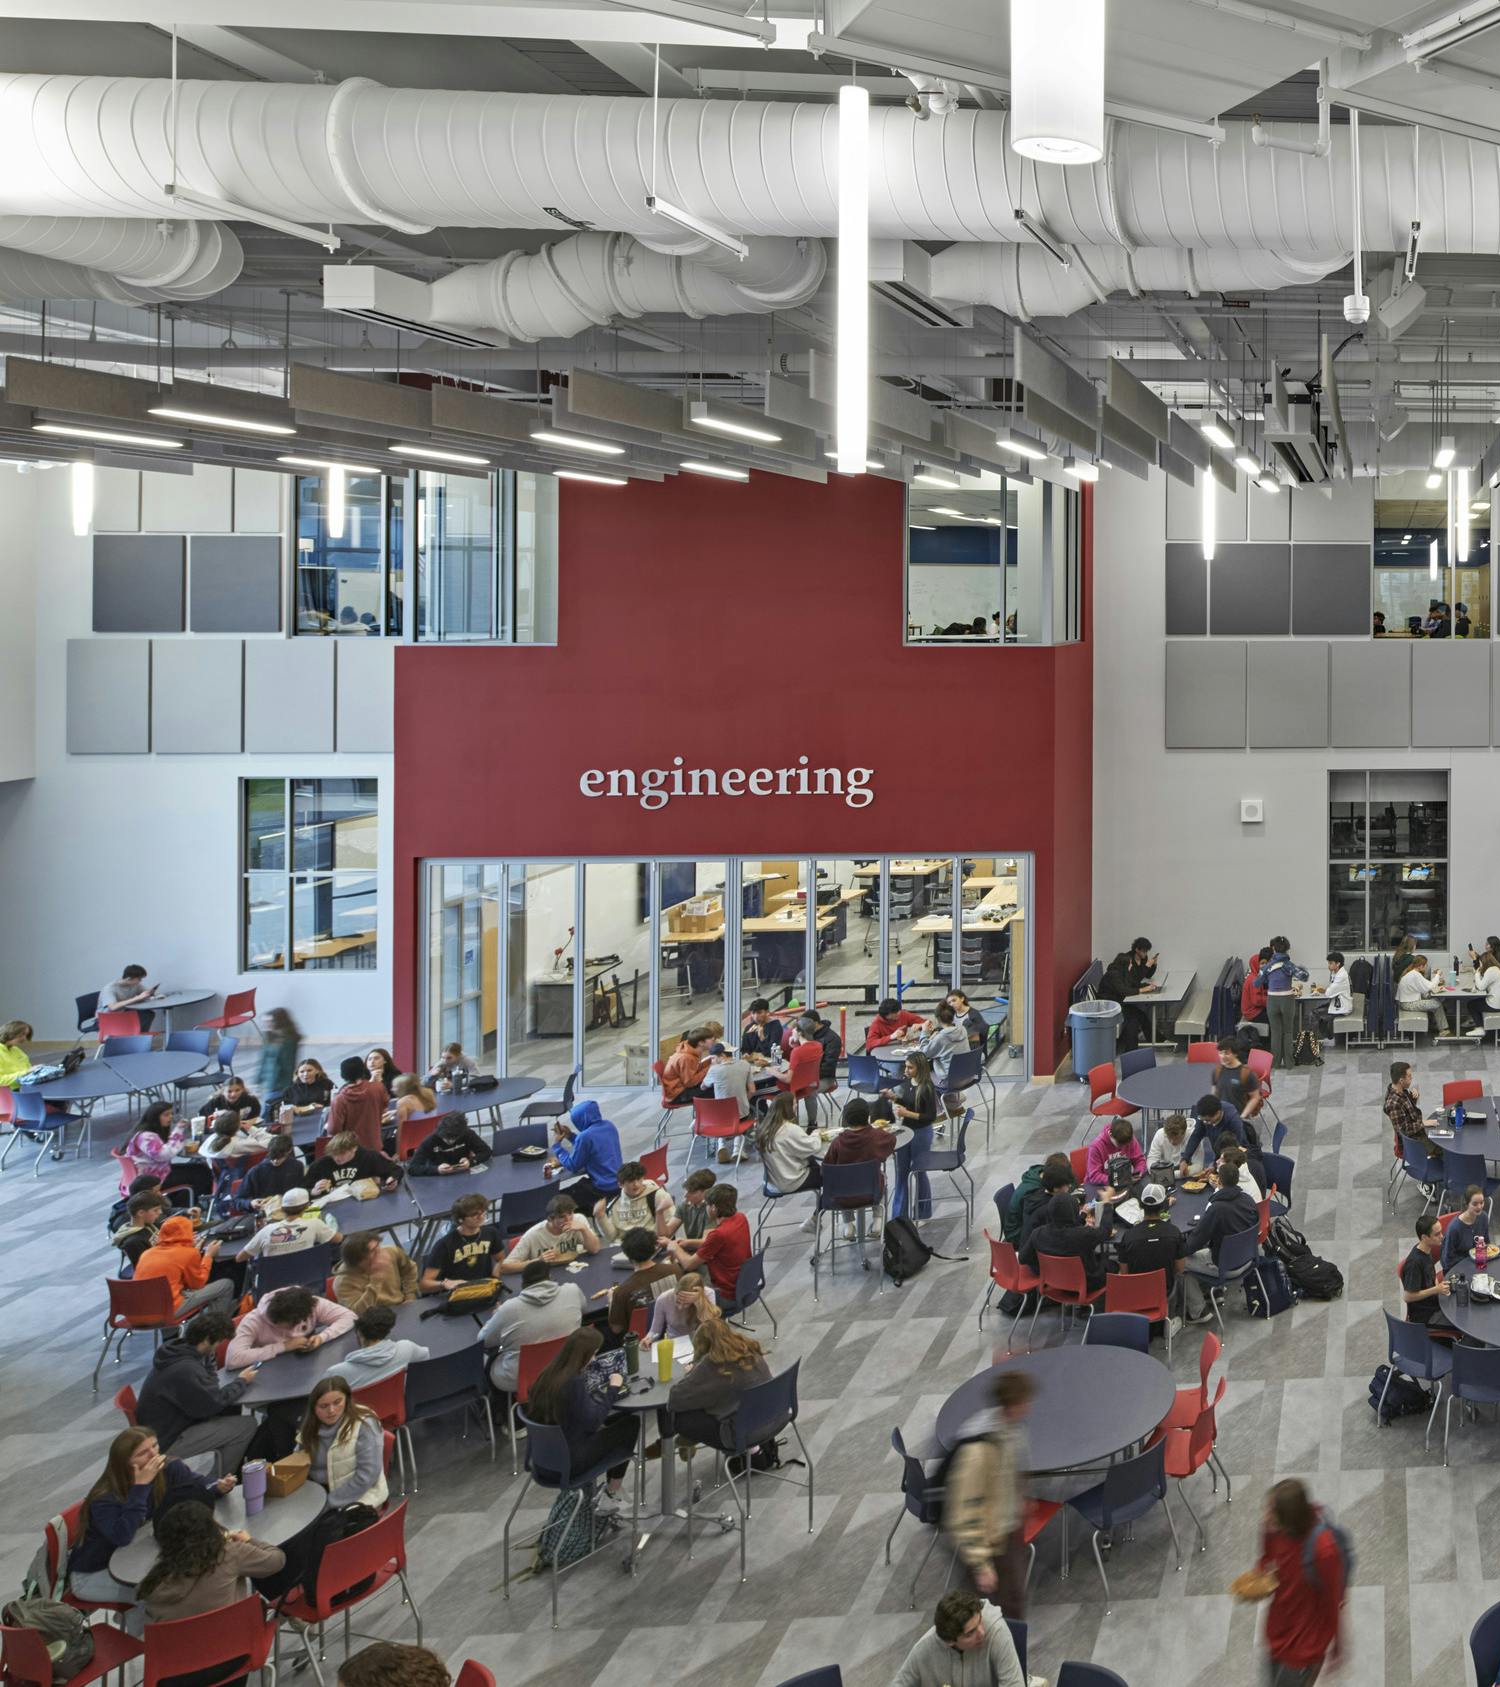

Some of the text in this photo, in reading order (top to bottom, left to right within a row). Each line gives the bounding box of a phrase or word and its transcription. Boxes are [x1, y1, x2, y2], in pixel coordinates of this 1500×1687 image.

[579, 755, 875, 811] engineering
[332, 1167, 358, 1181] NETS
[453, 1240, 491, 1264] ARMY
